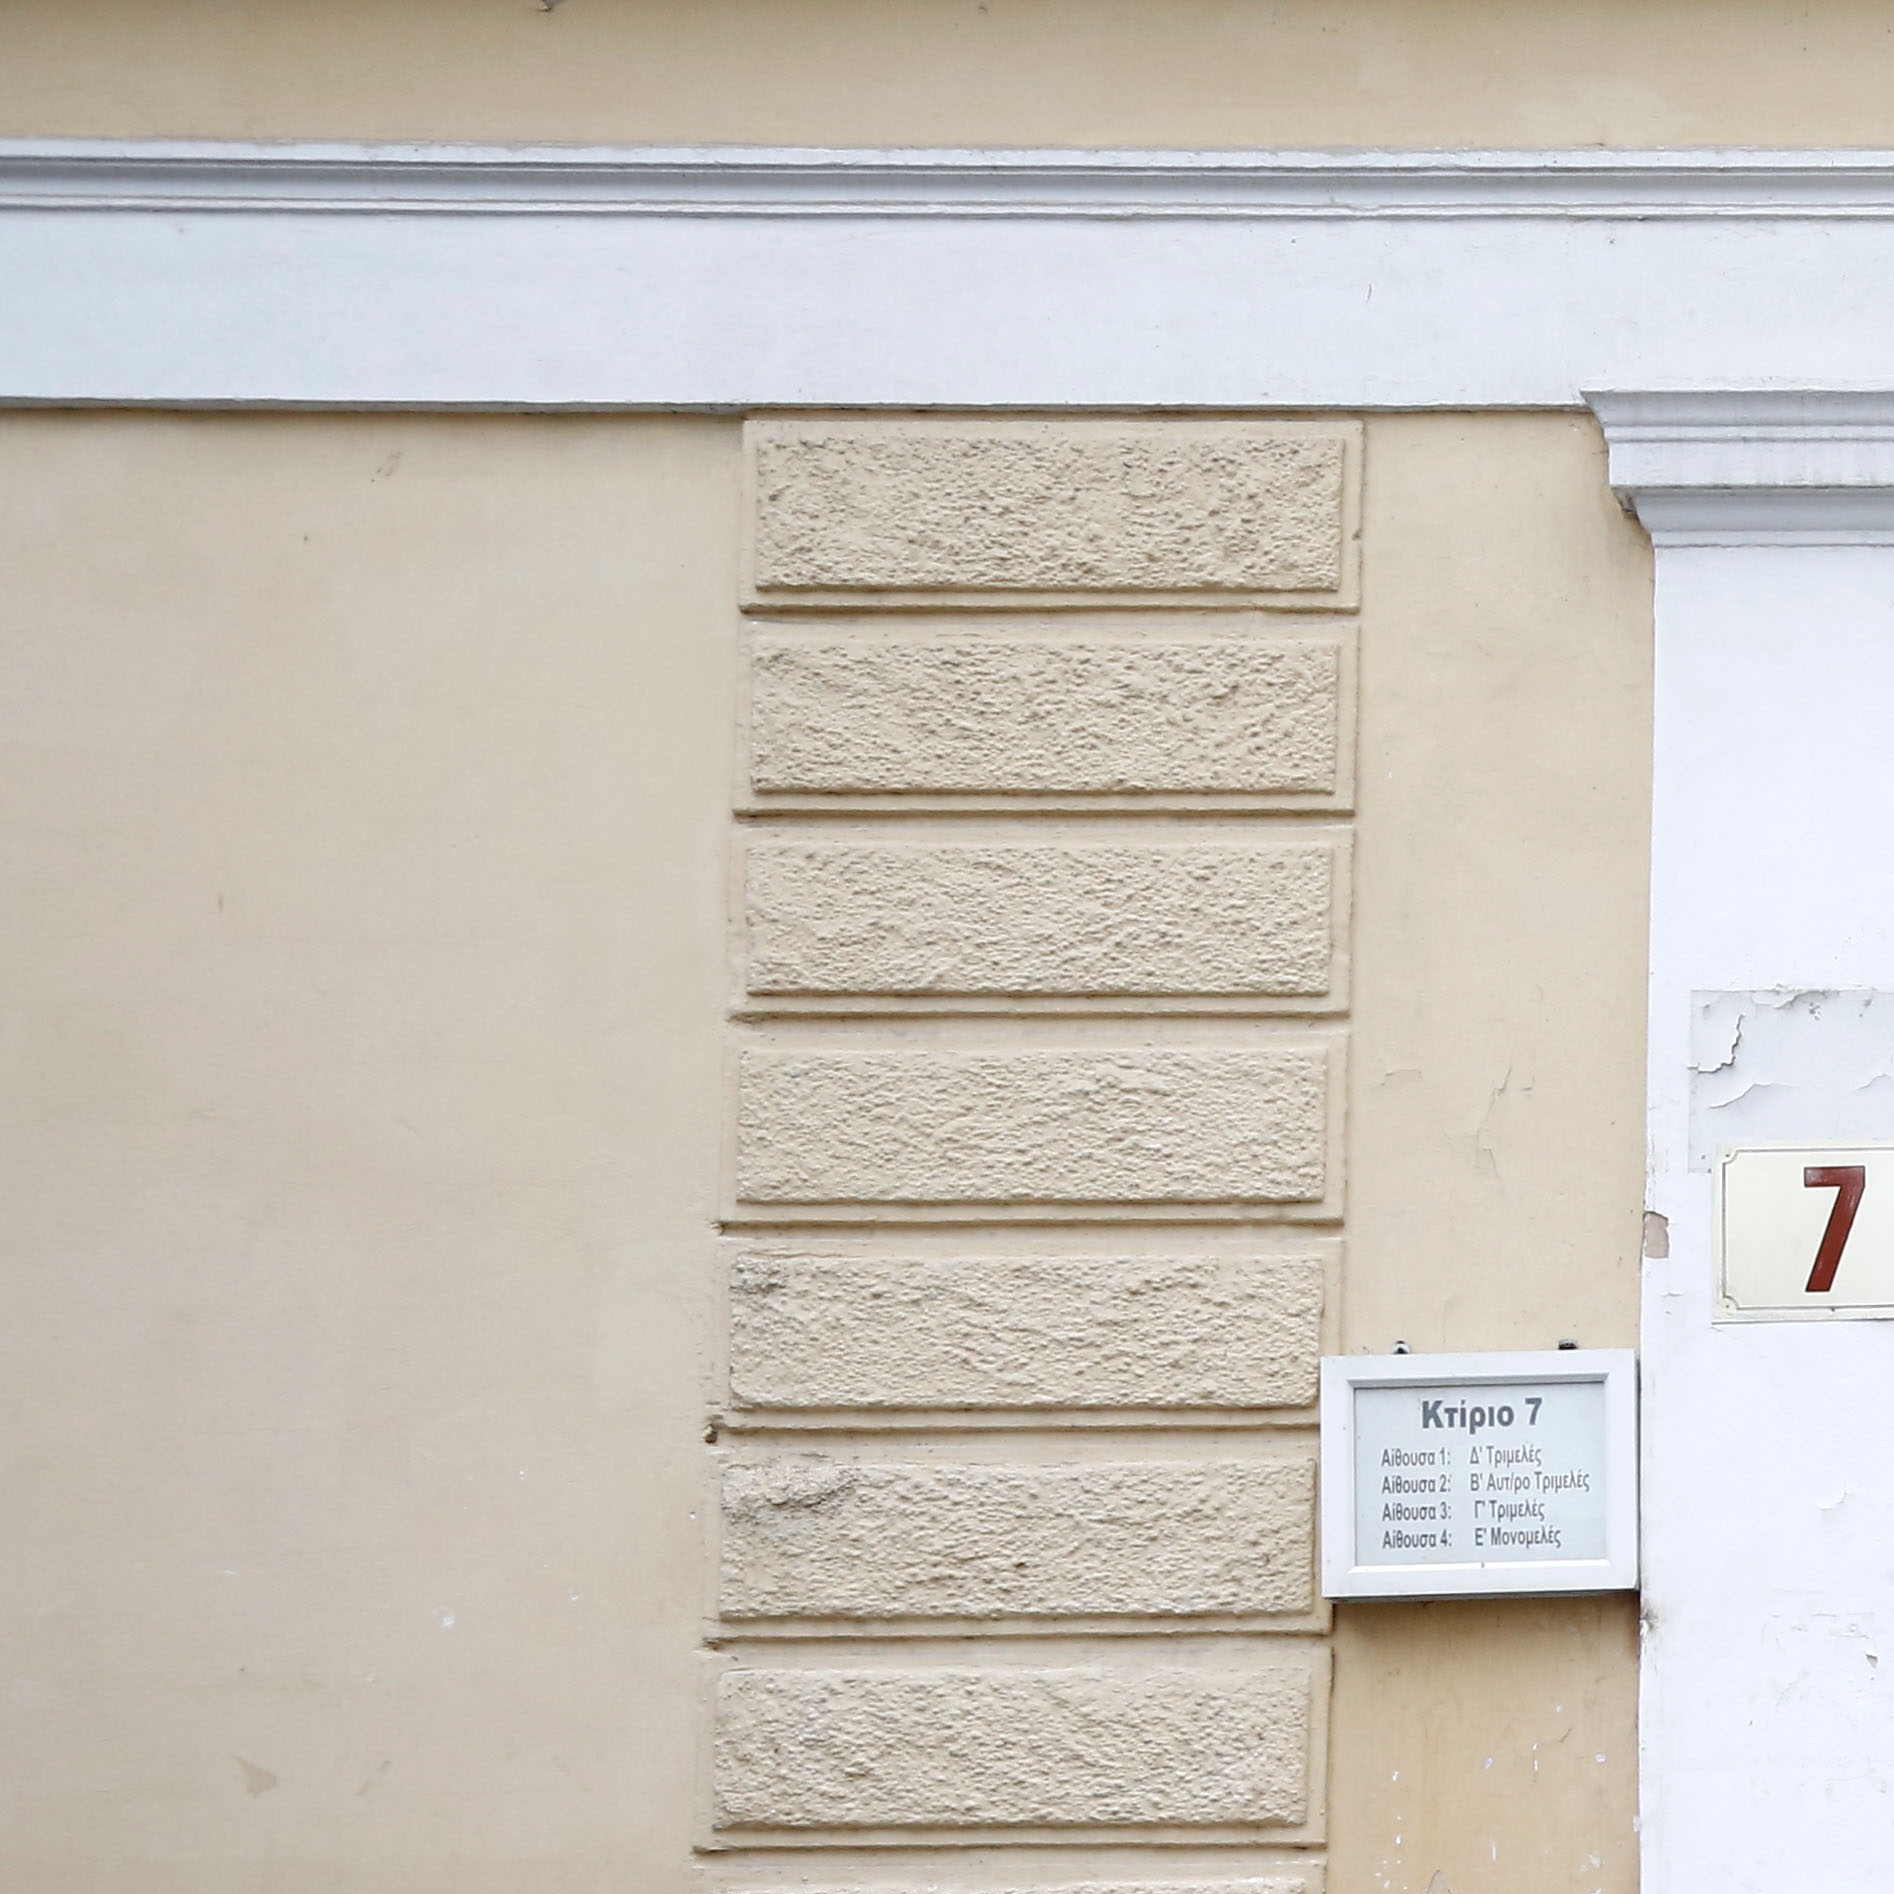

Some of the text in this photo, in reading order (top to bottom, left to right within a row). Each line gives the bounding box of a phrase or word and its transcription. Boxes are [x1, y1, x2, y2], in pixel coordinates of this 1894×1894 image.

[1804, 1165, 1866, 1293] 7
[1422, 1397, 1543, 1435] Κτίριο 7
[1381, 1448, 1435, 1467] Αίθουσα
[1439, 1447, 1451, 1466] 1:
[1486, 1444, 1543, 1468] Τριμελές
[1381, 1475, 1436, 1494] Αίθουσα
[1486, 1472, 1531, 1494] Αυτ/ρο
[1534, 1470, 1590, 1494] Τριμελές
[1382, 1503, 1436, 1521] Αίθουσα
[1440, 1502, 1452, 1519] 3:
[1488, 1499, 1545, 1522] Τριμελές
[1382, 1530, 1436, 1549] Αίθουσα
[1440, 1529, 1452, 1547] 4:
[1490, 1525, 1561, 1549] Μονομελές
